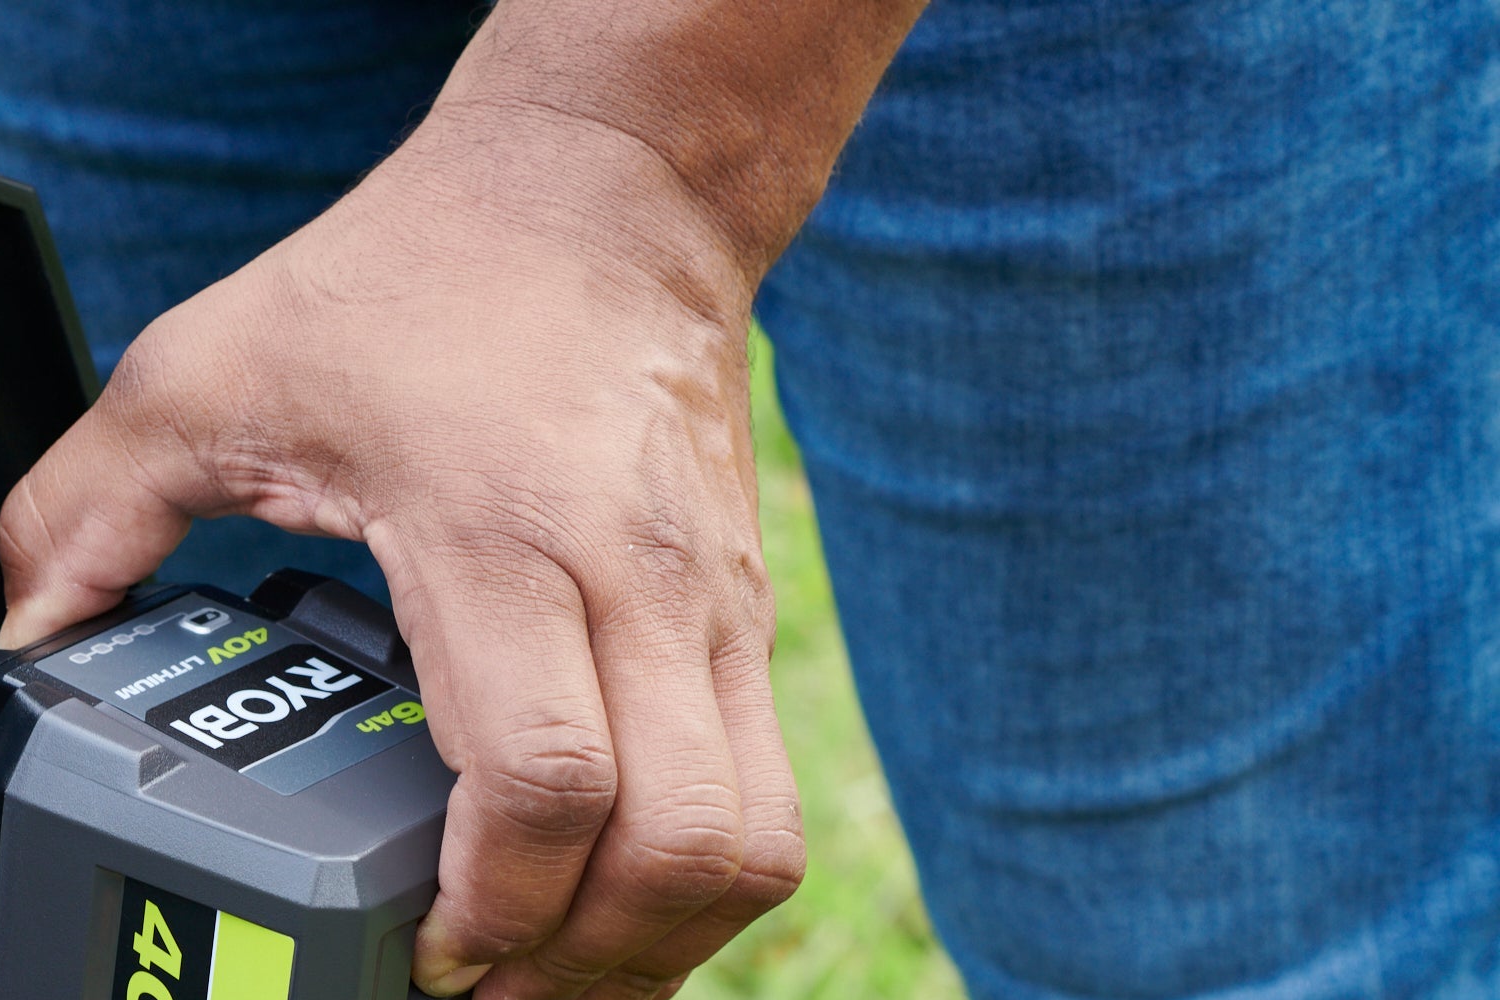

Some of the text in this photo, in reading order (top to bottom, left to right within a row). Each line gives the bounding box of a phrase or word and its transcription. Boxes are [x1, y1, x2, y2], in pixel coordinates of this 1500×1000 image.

[114, 627, 268, 700] 40V LITHIUM
[169, 656, 363, 749] RYOBI
[356, 701, 427, 733] 6Ah
